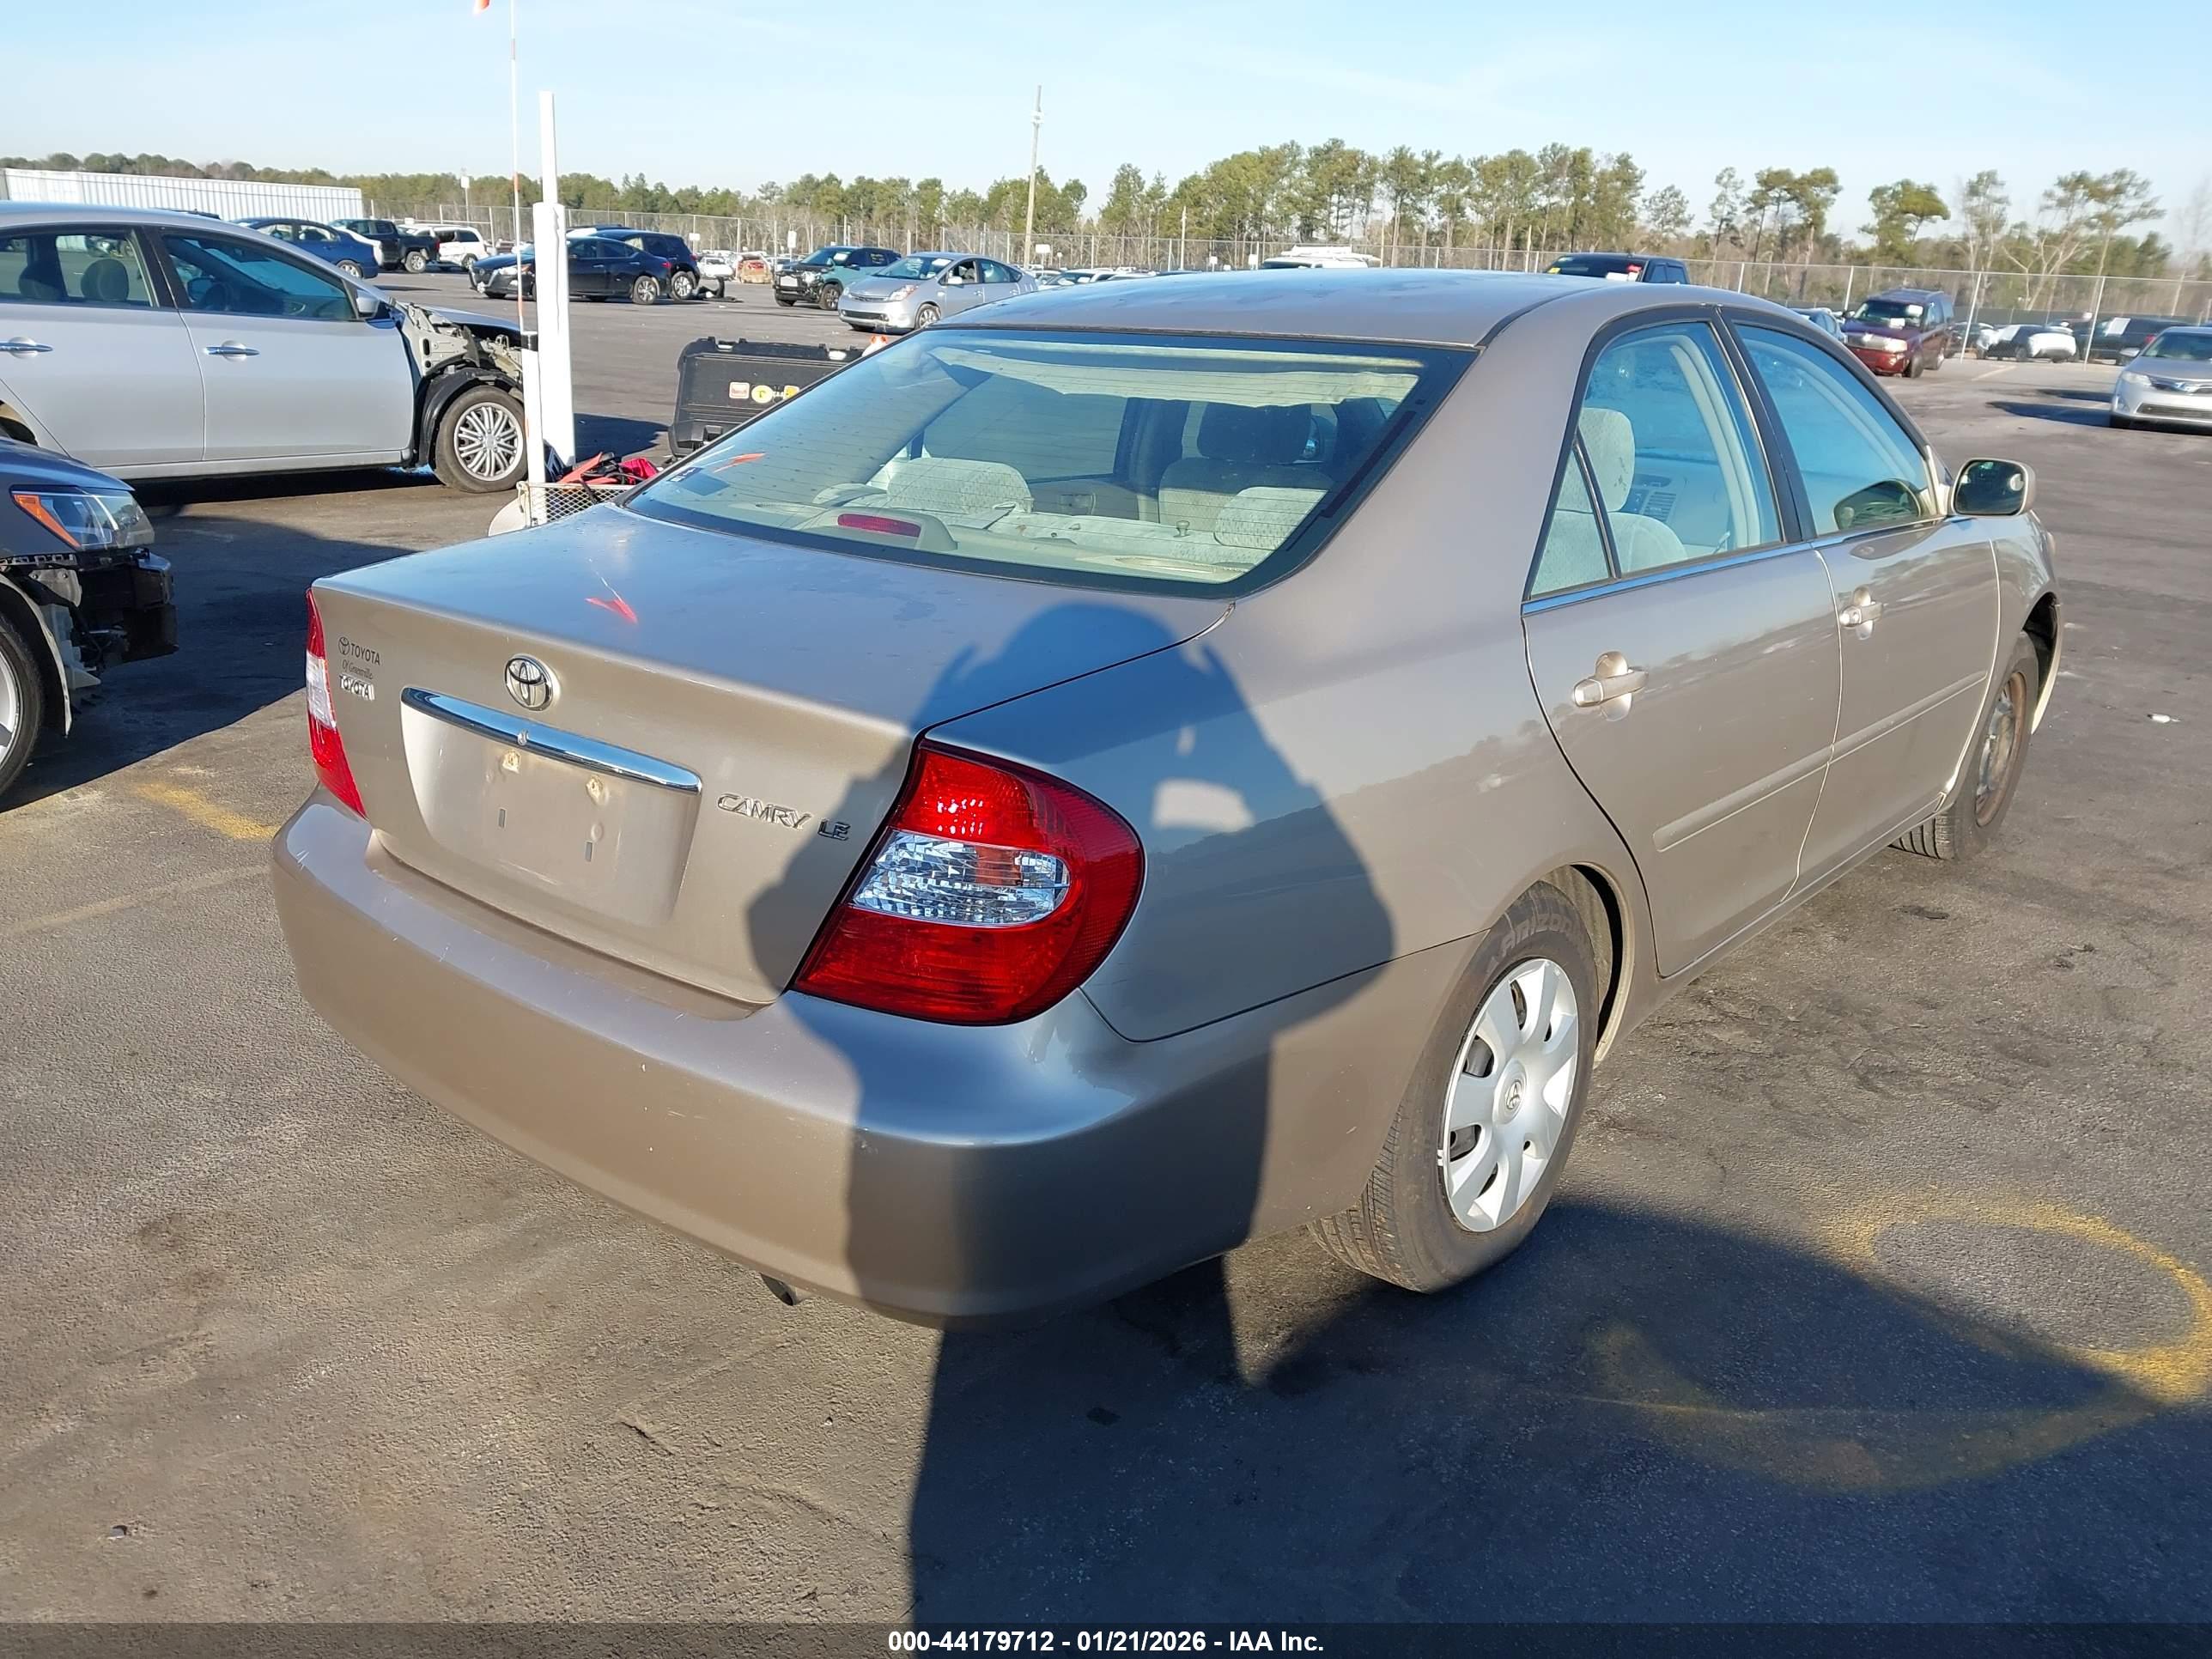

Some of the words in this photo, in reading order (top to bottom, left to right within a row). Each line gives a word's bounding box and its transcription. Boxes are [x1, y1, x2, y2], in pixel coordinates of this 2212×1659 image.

[350, 643, 380, 666] TOYOTA
[338, 674, 374, 701] TOYOTA
[717, 793, 812, 830] CAMRY
[817, 817, 851, 842] LE
